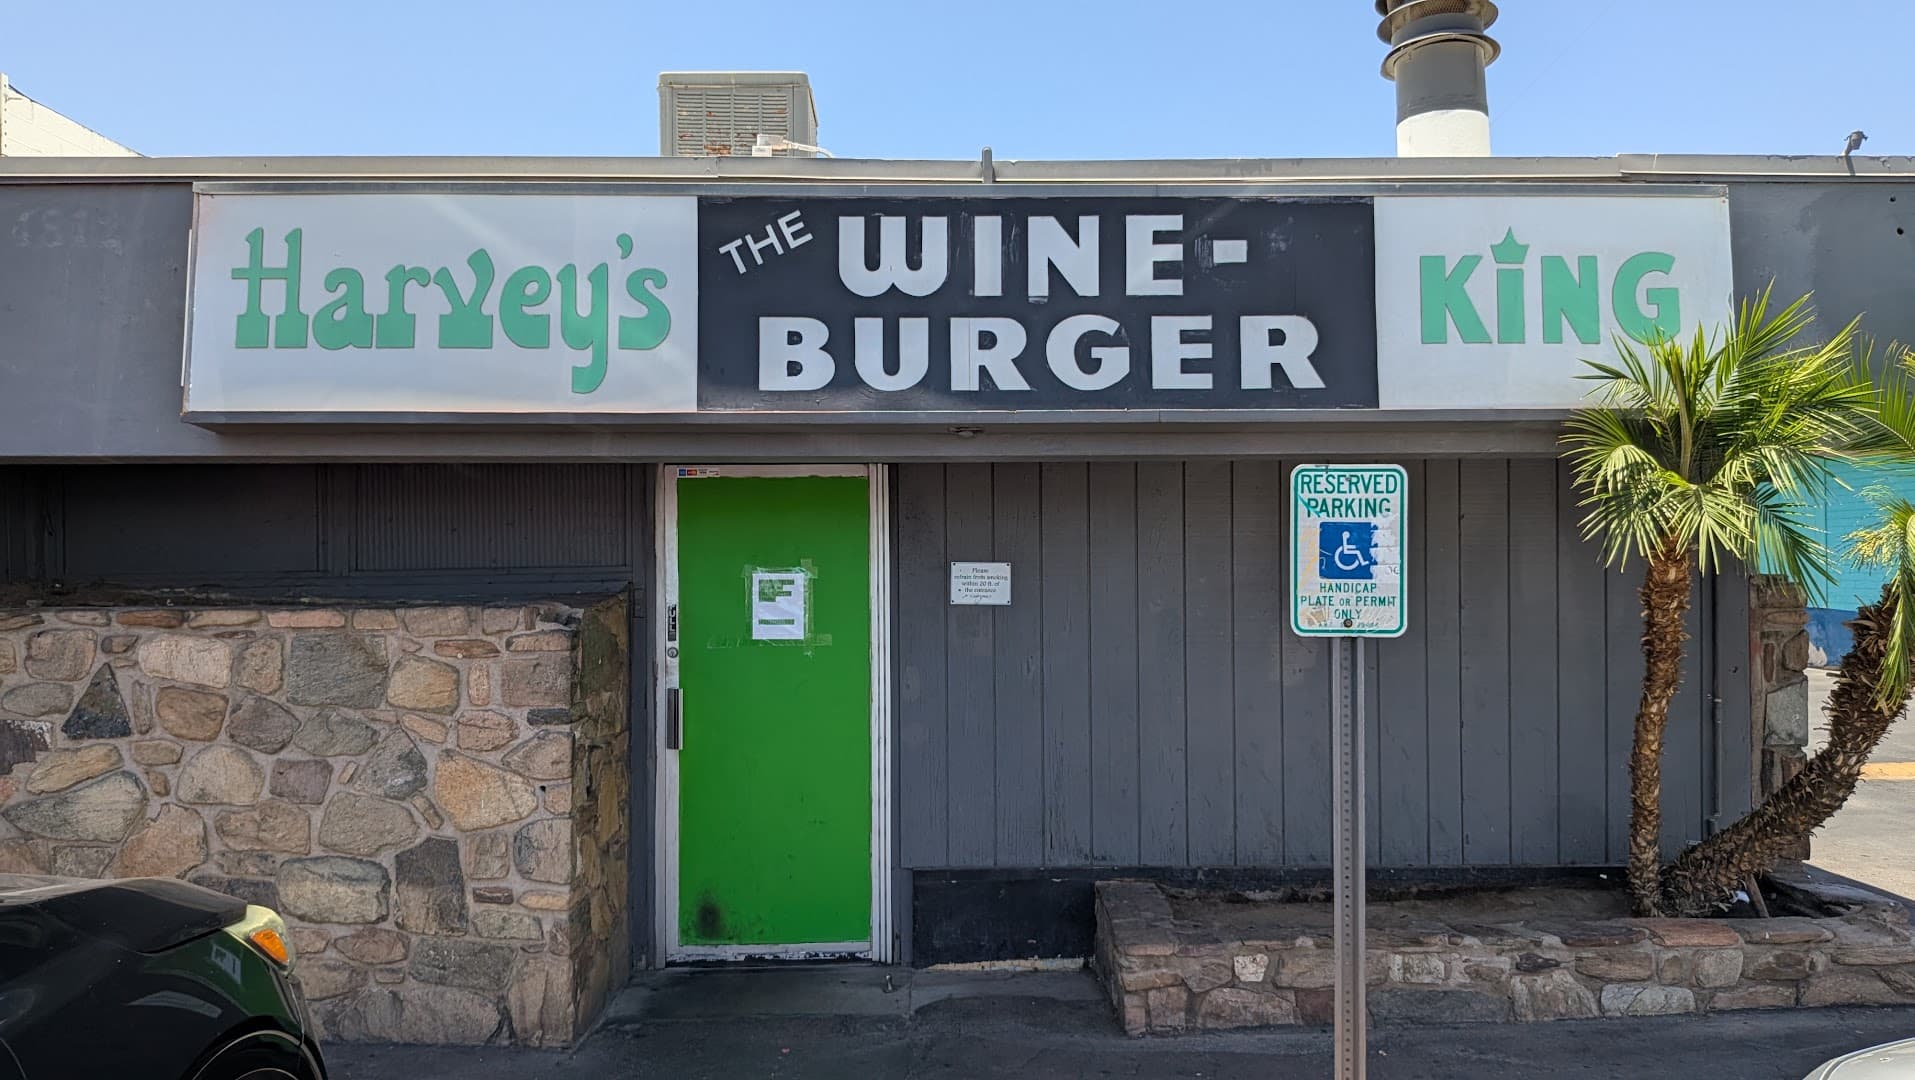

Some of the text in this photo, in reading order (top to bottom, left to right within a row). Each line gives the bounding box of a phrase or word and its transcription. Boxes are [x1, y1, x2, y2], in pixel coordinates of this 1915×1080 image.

[718, 210, 814, 275] THE
[837, 213, 1249, 298] WINE-
[231, 226, 672, 395] Harvey's
[758, 313, 1328, 392] BURGER
[1300, 474, 1398, 494] RESERVED
[1307, 497, 1391, 518] PARKING
[1319, 582, 1377, 593] HANDICAP
[1300, 595, 1397, 607] PLATE OR PERMIT
[1334, 608, 1362, 620] ONLY
